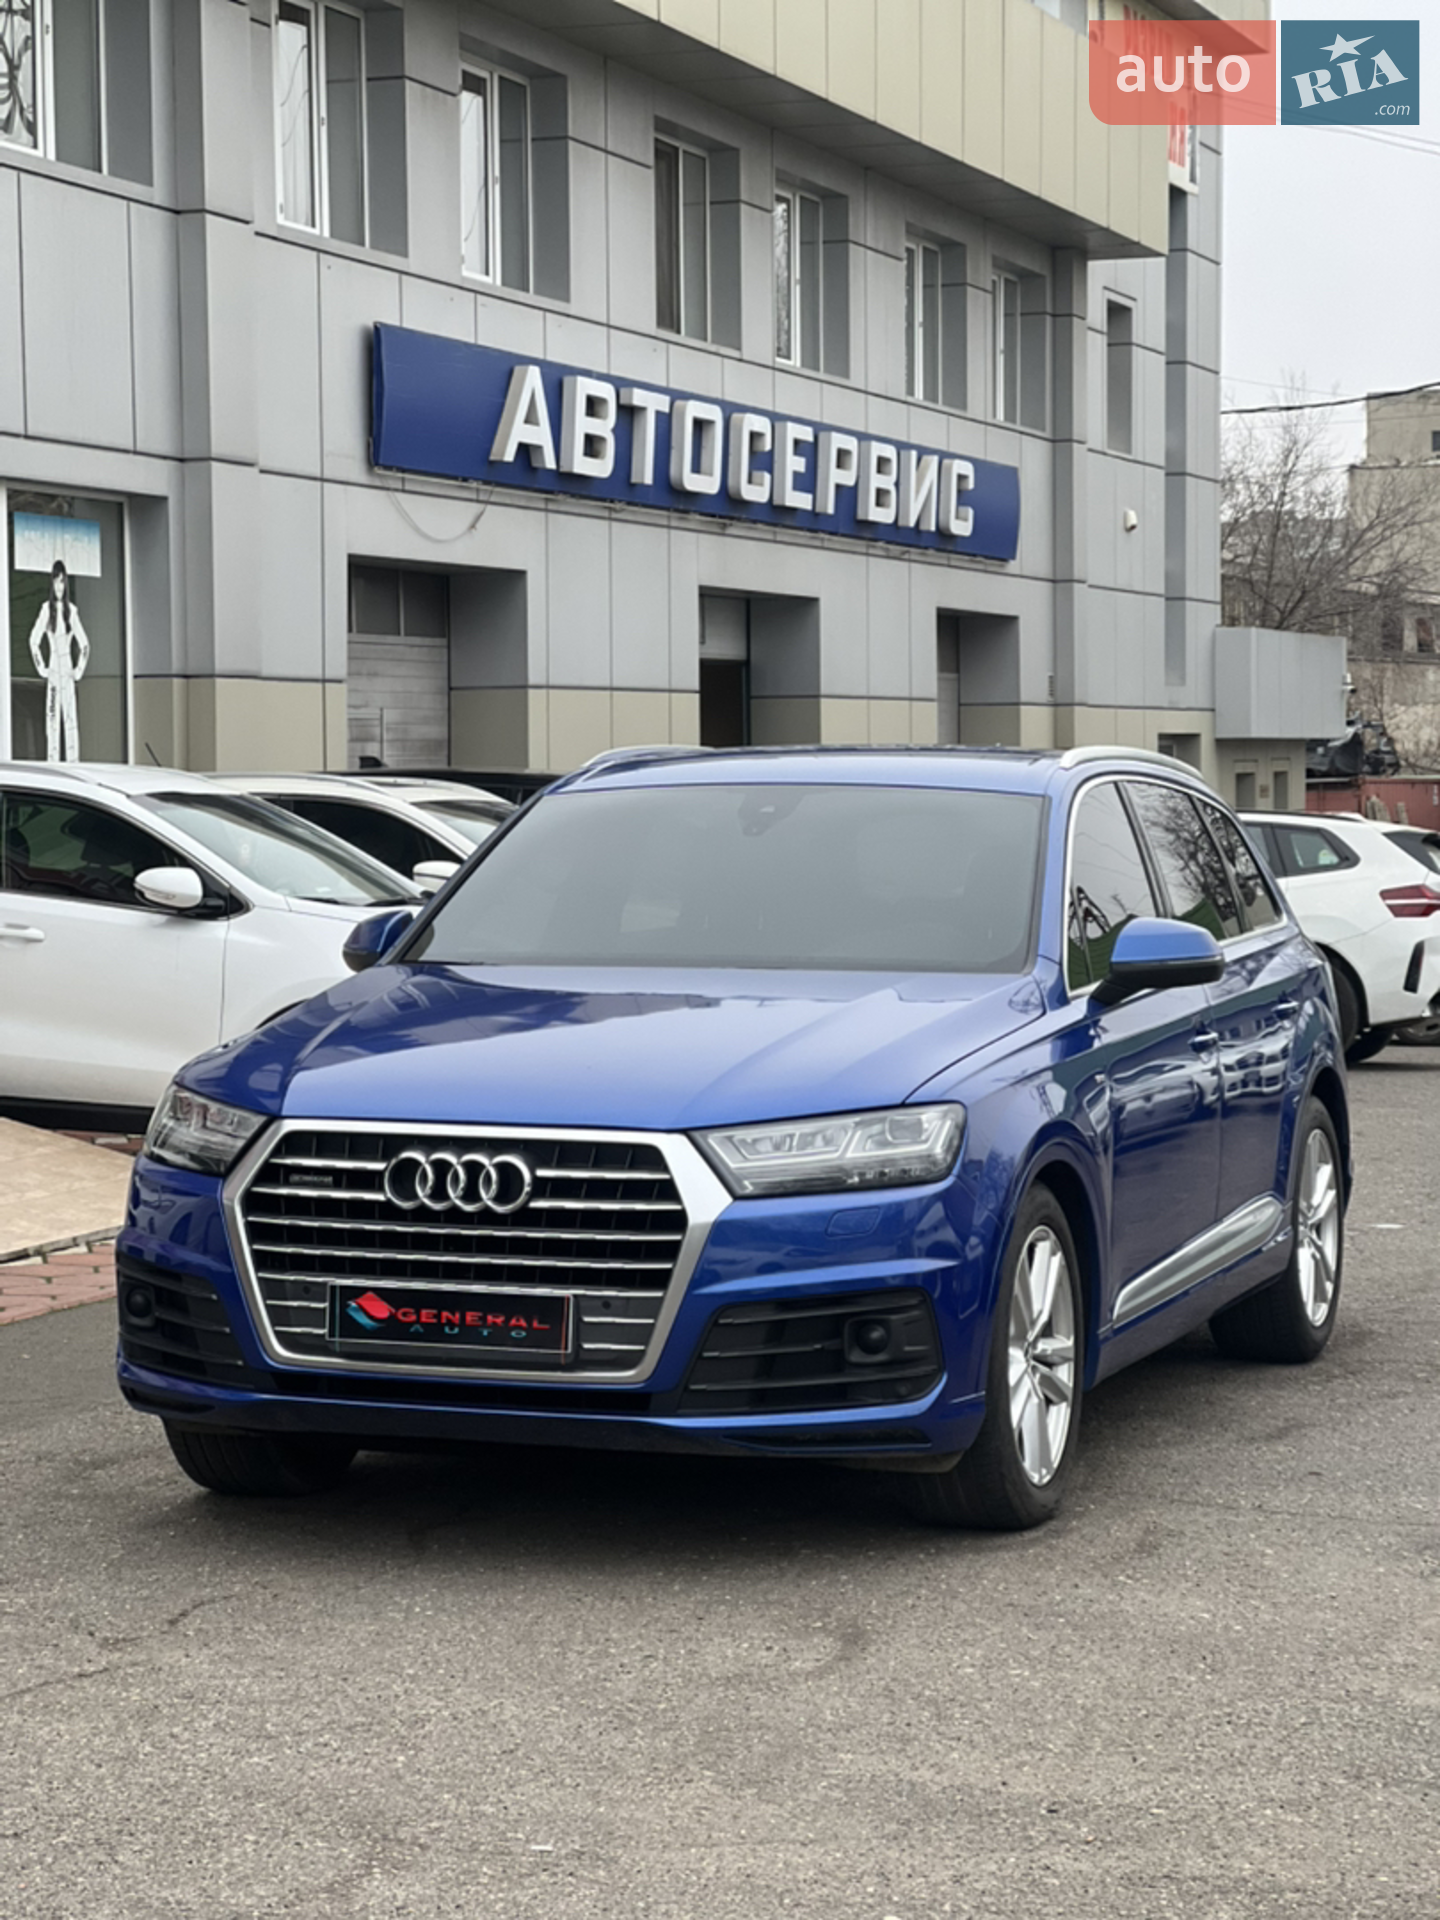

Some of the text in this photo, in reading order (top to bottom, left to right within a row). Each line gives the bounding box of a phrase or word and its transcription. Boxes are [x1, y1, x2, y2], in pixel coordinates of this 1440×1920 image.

[489, 364, 975, 538] АВТОСЕРВИС
[396, 1307, 551, 1331] GENERAL
[410, 1324, 528, 1338] AUTO
